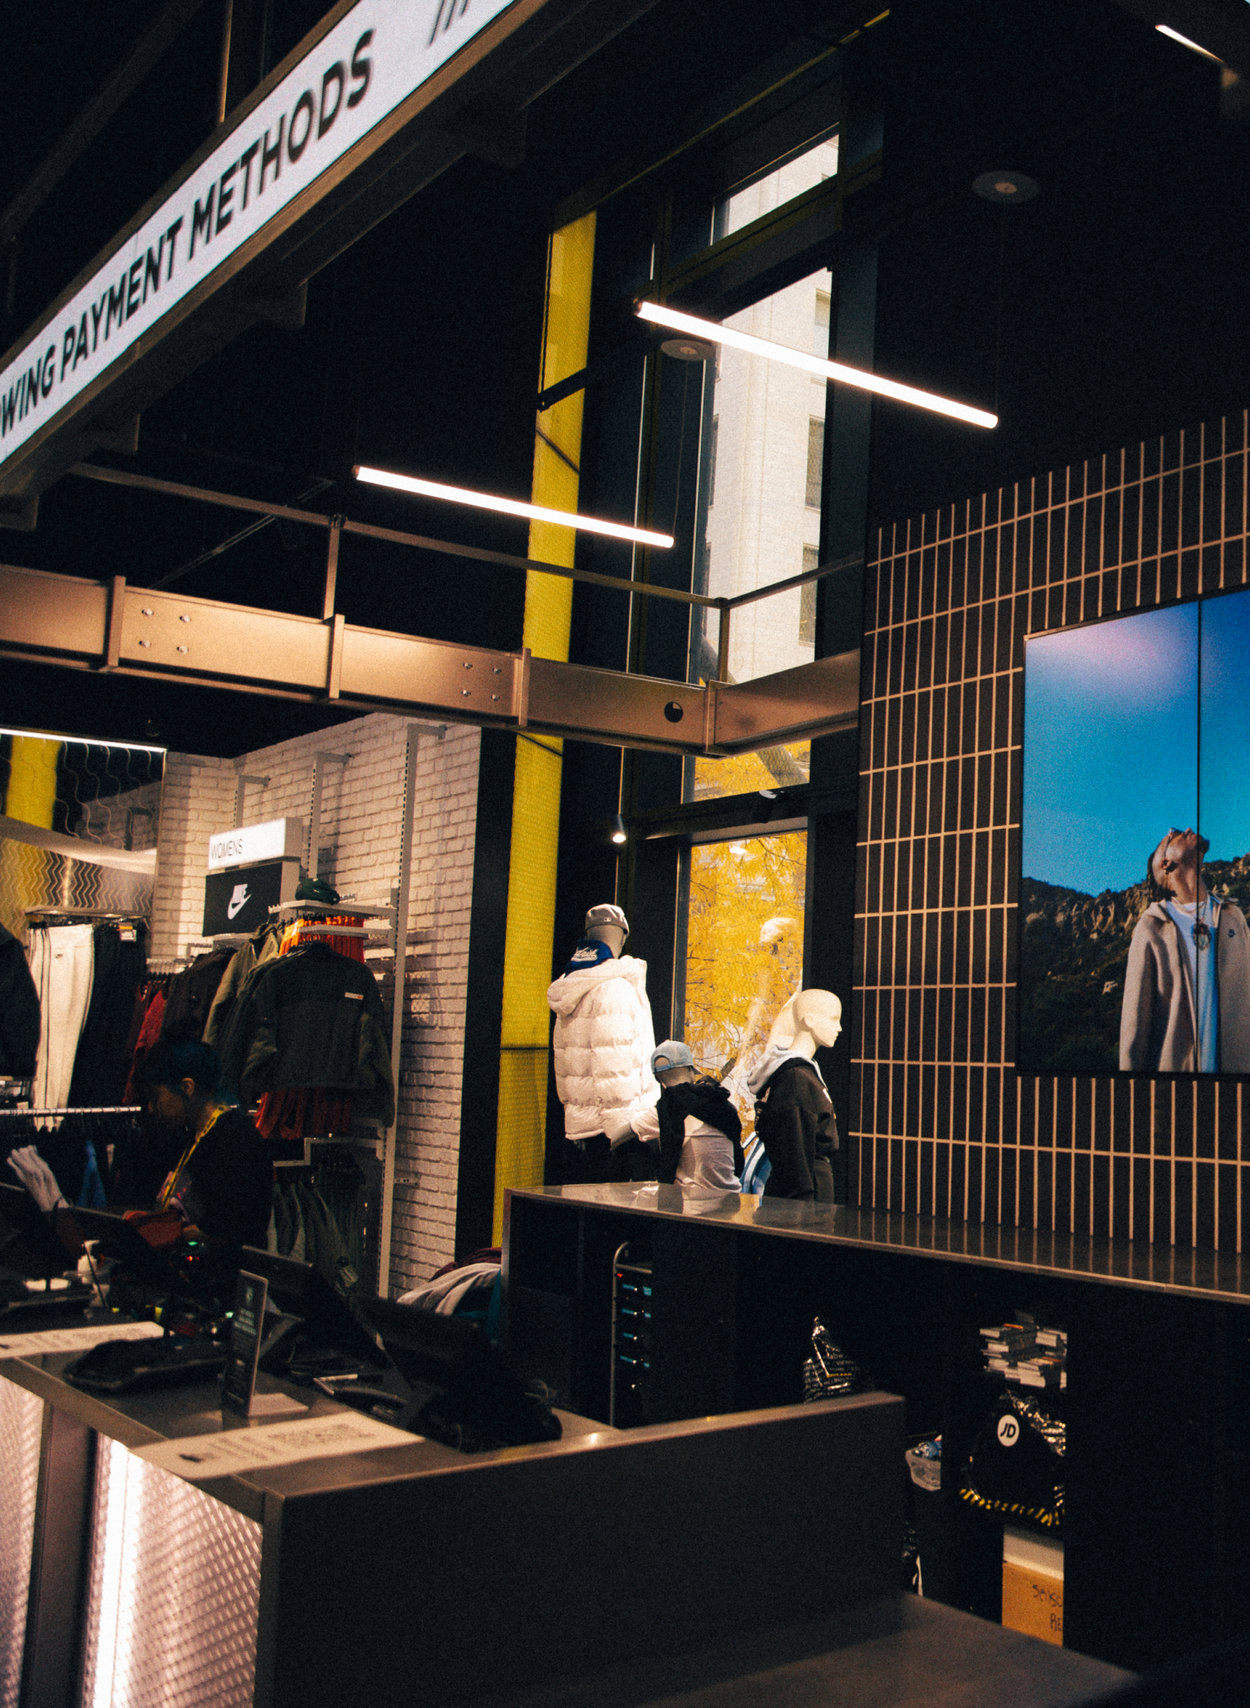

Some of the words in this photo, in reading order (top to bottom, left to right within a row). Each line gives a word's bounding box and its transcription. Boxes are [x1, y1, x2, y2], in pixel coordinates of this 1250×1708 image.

[1, 344, 56, 438] WING
[60, 215, 184, 383] PAYMENT
[188, 28, 377, 263] METHODS
[211, 838, 243, 859] WOMENS
[1000, 1422, 1016, 1438] JD
